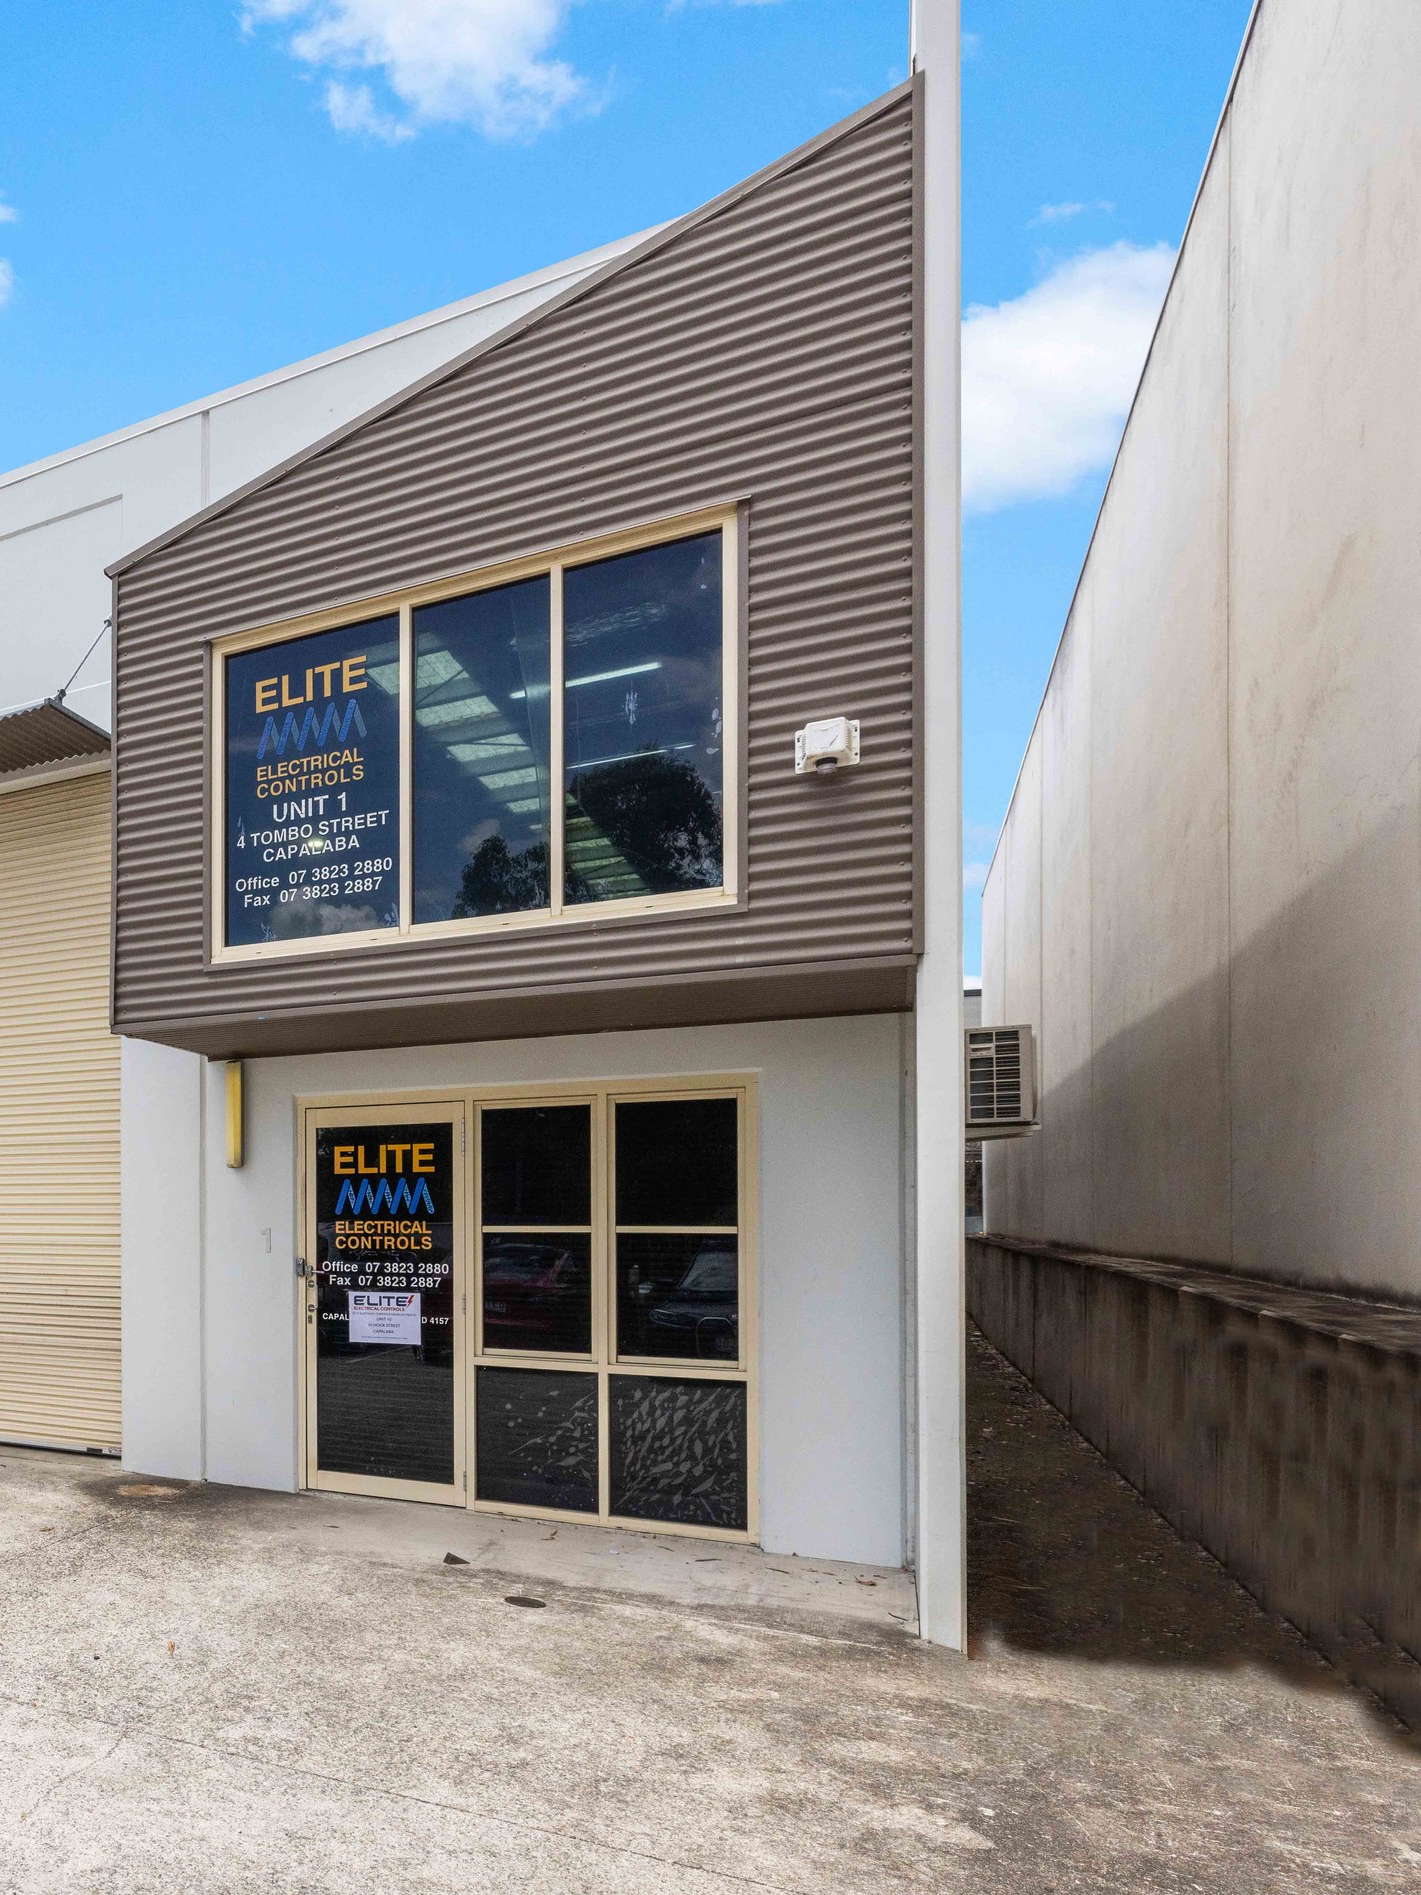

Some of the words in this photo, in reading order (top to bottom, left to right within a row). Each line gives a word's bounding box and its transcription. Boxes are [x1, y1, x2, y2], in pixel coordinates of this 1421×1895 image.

[255, 654, 368, 714] ELITE
[256, 747, 364, 782] ELECTRICAL
[256, 764, 364, 799] CONTROLS
[272, 794, 329, 823] UNIT
[337, 791, 347, 811] 1
[236, 835, 246, 849] 4
[250, 824, 313, 847] TOMBO
[318, 810, 390, 836] STREET
[263, 834, 360, 863] CAPALABA
[235, 875, 280, 892] Office
[288, 870, 306, 885] 07
[311, 864, 349, 881] 3823
[354, 857, 393, 875] 2880
[244, 894, 271, 908] Fax
[279, 889, 297, 903] 07
[302, 883, 340, 900] 3823
[344, 876, 383, 894] 2887
[333, 1143, 435, 1175] ELITE
[261, 1227, 271, 1253] 1
[335, 1220, 432, 1234] ELECTRICAL
[335, 1236, 432, 1250] CONTROLS
[322, 1261, 358, 1272] Office
[365, 1262, 380, 1273] 07
[384, 1262, 414, 1273] 3823
[418, 1263, 449, 1274] 2880
[329, 1275, 351, 1286] Fax
[358, 1275, 373, 1286] 07
[376, 1276, 406, 1287] 3823
[410, 1277, 441, 1288] 2887
[354, 1295, 409, 1307] ELITE
[322, 1312, 349, 1321] CAPAL
[429, 1317, 449, 1325] 4157
